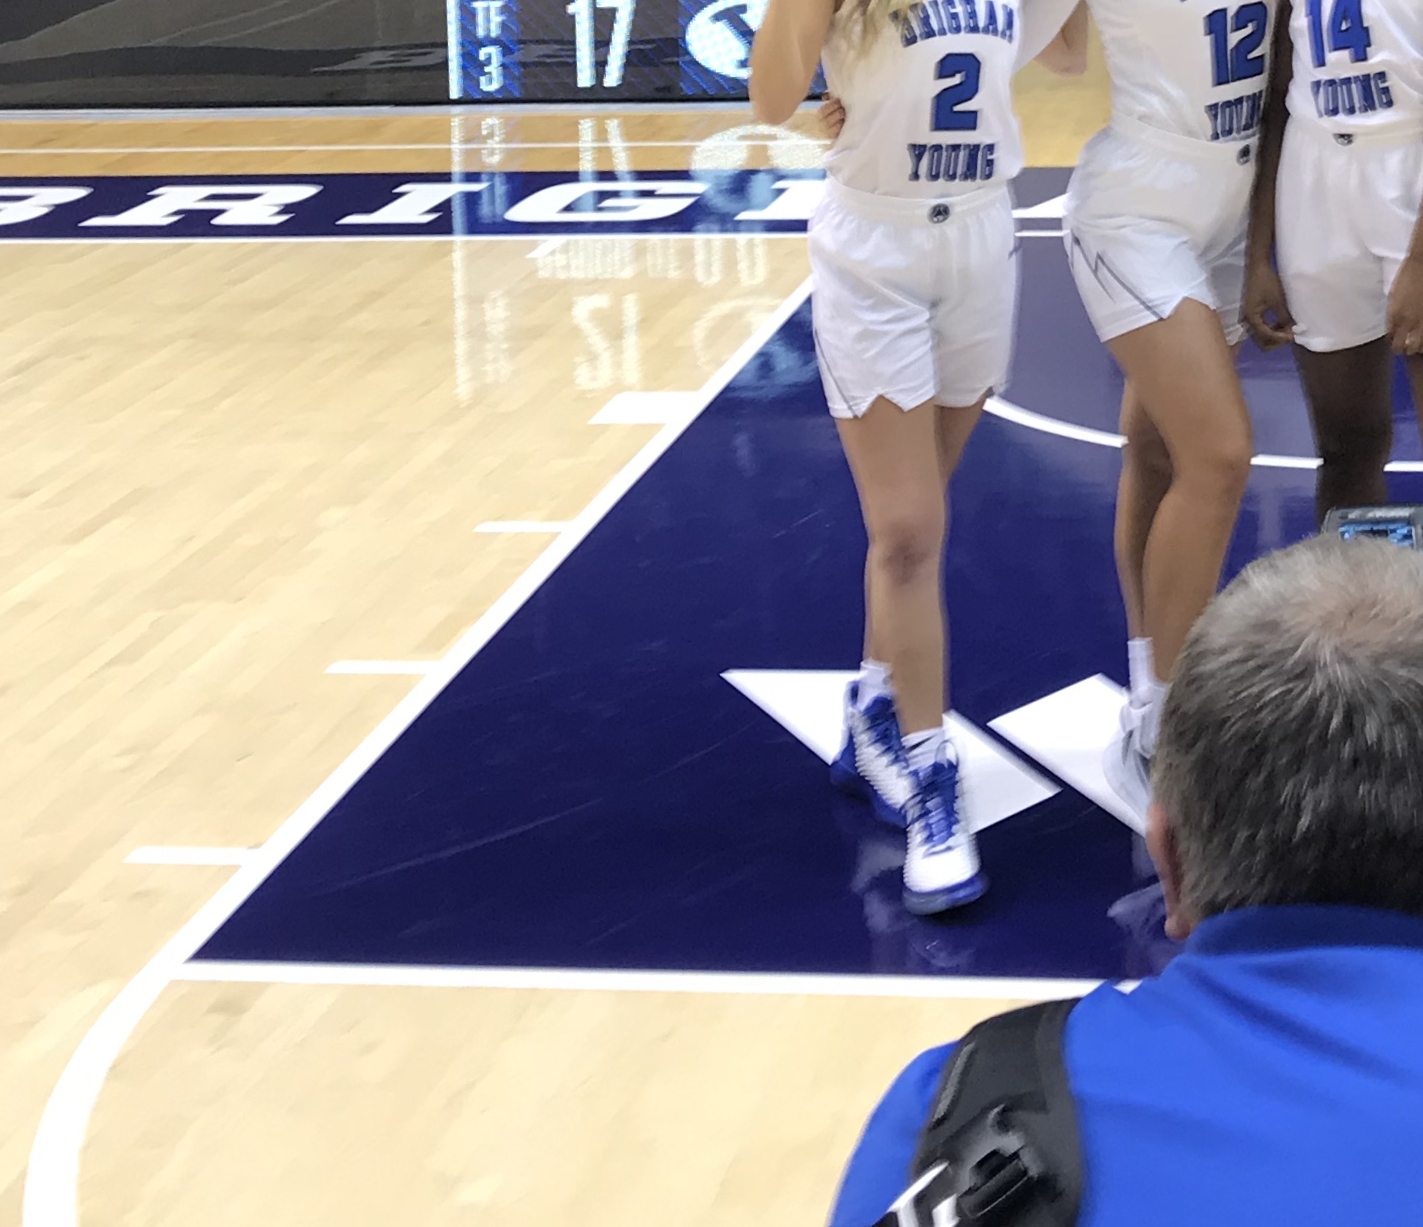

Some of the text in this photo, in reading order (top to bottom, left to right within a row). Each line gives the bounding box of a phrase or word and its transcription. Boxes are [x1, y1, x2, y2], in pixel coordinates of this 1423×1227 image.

[471, 0, 506, 38] TF
[1203, 1, 1268, 87] 12
[478, 47, 503, 92] 3
[929, 52, 982, 132] 2
[1311, 71, 1395, 118] YOUNG
[907, 143, 995, 181] YOUNG
